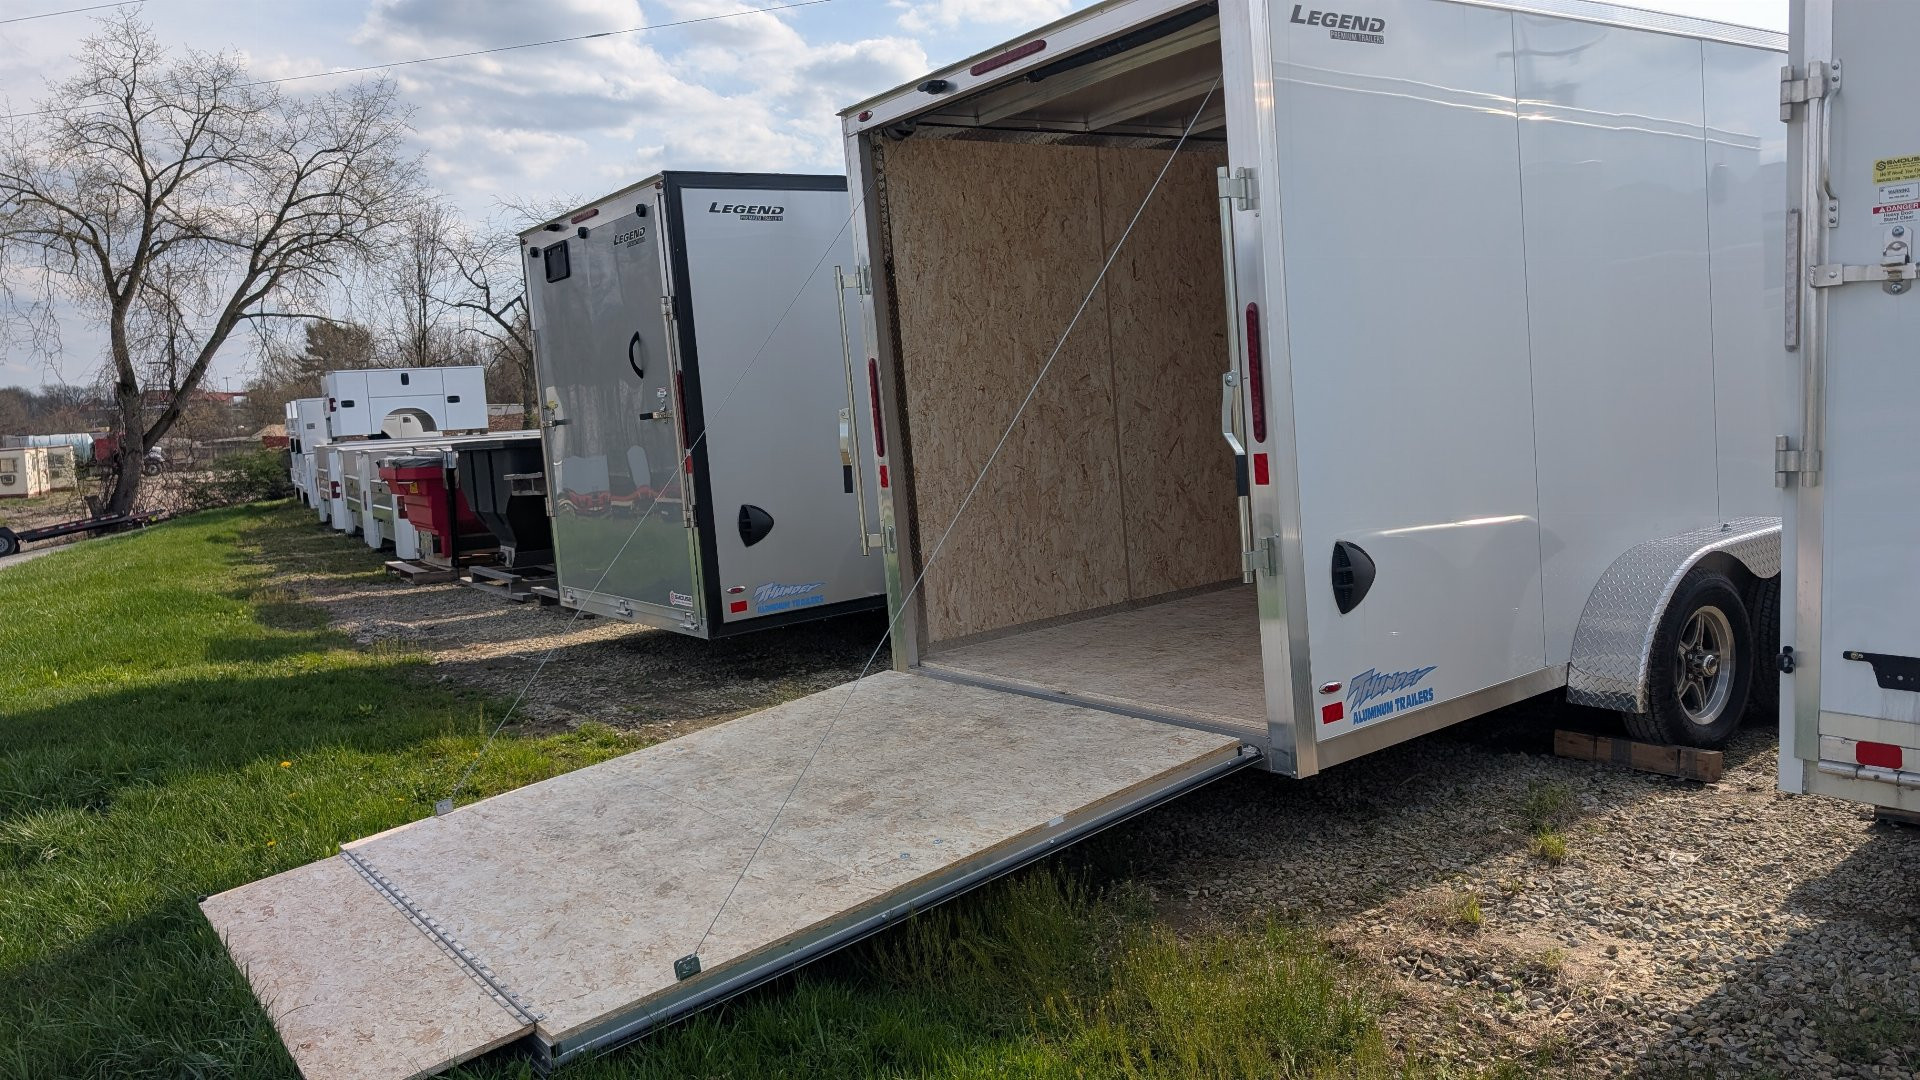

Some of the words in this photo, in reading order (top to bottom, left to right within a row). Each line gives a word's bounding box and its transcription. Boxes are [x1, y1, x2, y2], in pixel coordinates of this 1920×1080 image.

[1290, 4, 1386, 33] LEGEND
[1330, 30, 1358, 41] PREMIUM
[1358, 32, 1385, 44] TRAILERS
[708, 201, 785, 215] LEGEND
[1886, 202, 1919, 212] DANGER
[613, 226, 646, 246] LEGEND
[1353, 700, 1394, 725] ALUMINUM
[1395, 687, 1434, 712] TRAILERS
